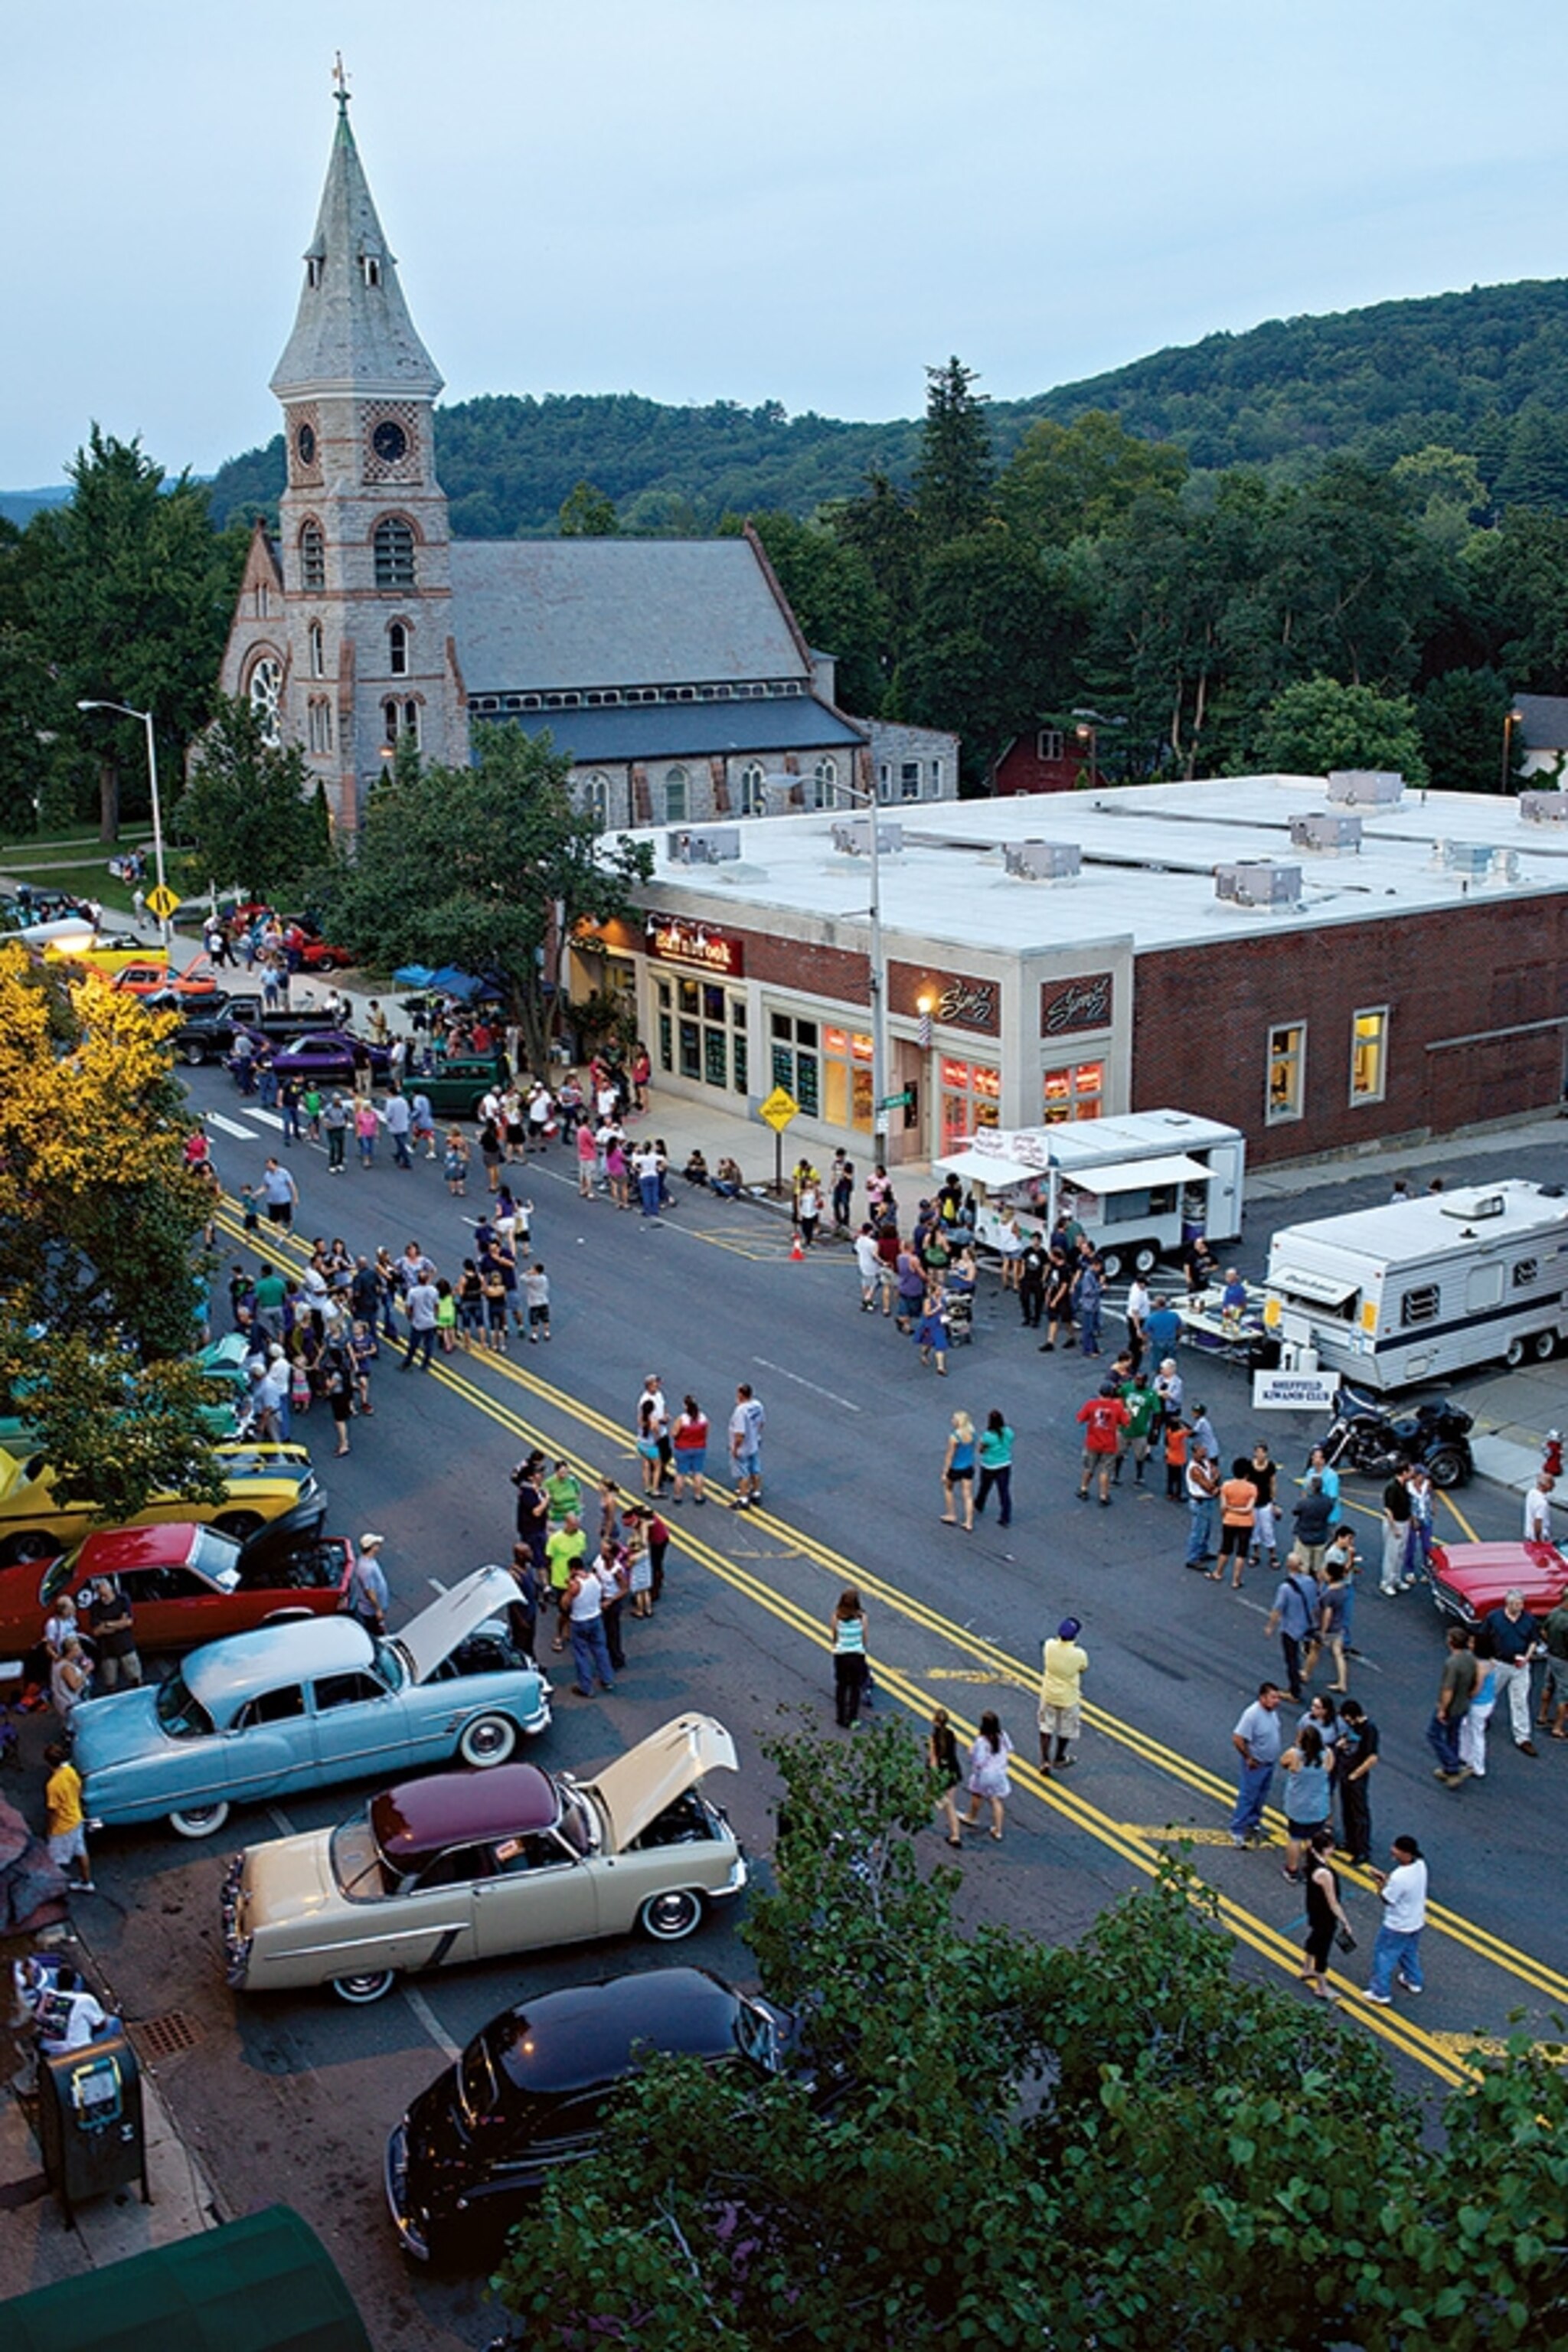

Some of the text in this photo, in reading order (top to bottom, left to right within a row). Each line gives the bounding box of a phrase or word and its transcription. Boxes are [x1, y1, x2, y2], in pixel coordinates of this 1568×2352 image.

[1272, 1380, 1323, 1390] SHEFFIELD
[1263, 1390, 1330, 1401] KIWANIS CLUB
